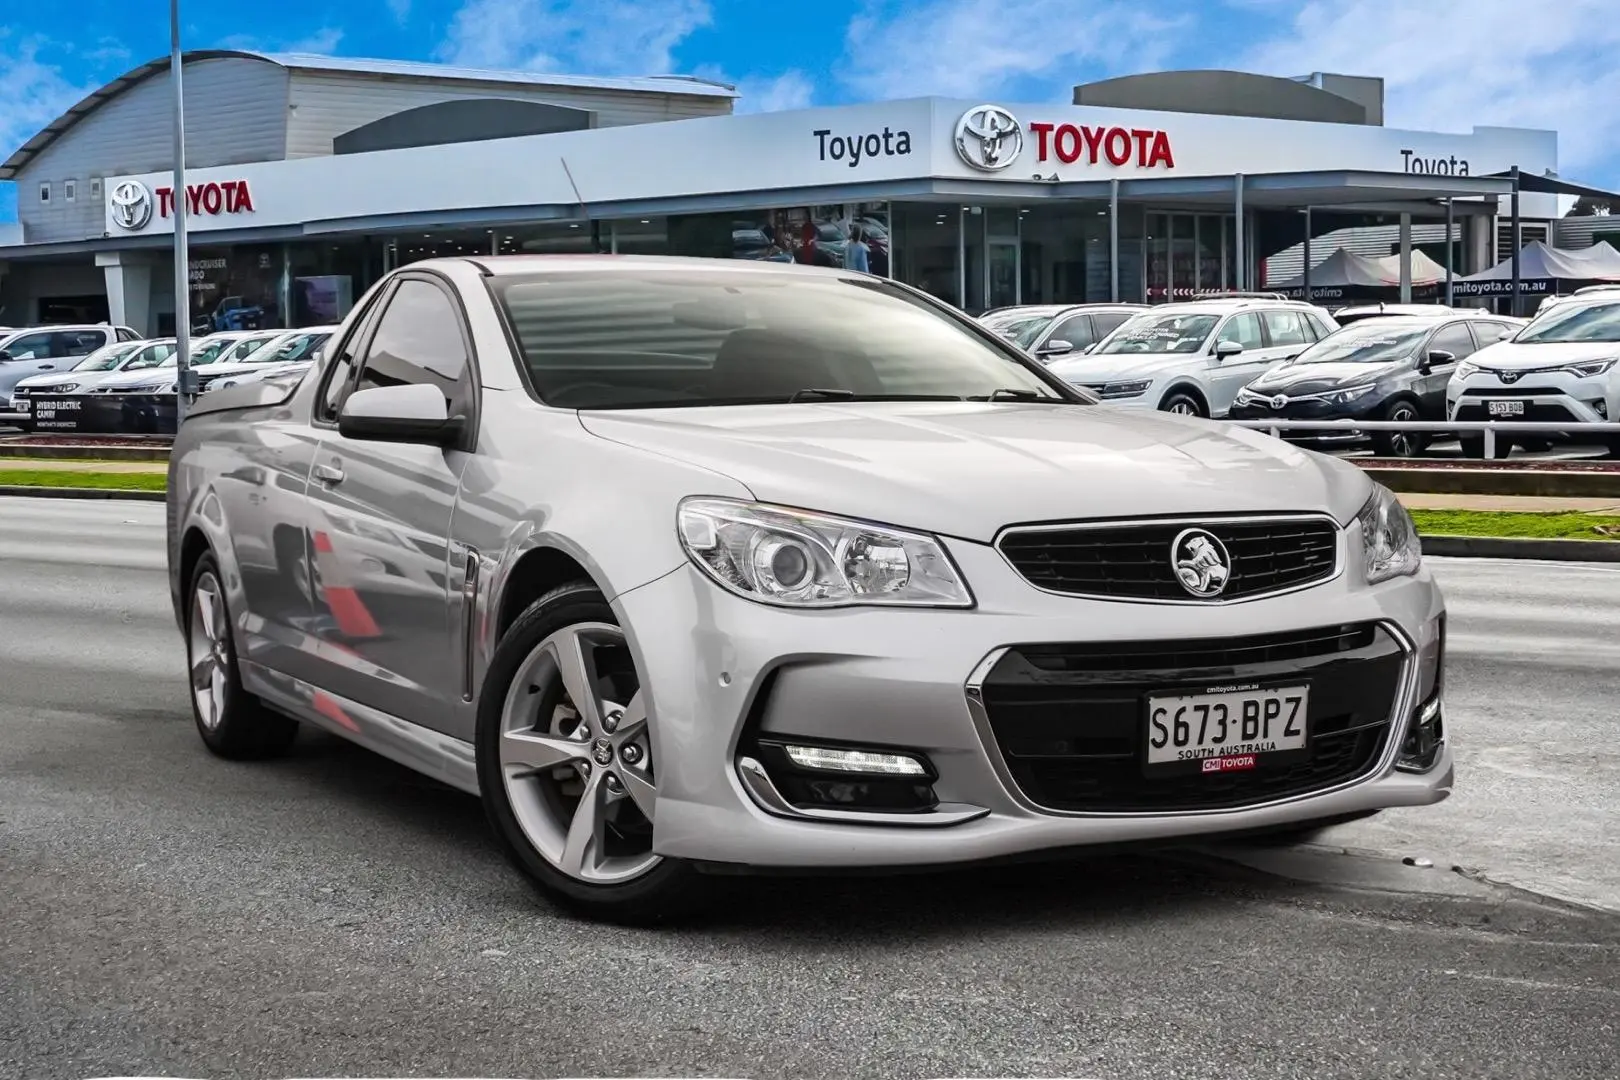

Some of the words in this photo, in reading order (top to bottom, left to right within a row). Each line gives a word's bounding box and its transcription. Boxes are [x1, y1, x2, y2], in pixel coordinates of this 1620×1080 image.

[813, 127, 911, 167] Toyota
[1030, 122, 1174, 168] TOYOTA
[1453, 281, 1546, 295] mitoyota.cm.au
[1178, 747, 1214, 759] SOUTH
[1219, 742, 1276, 755] AUSTRALIA
[1222, 757, 1254, 767] TOYOTA
